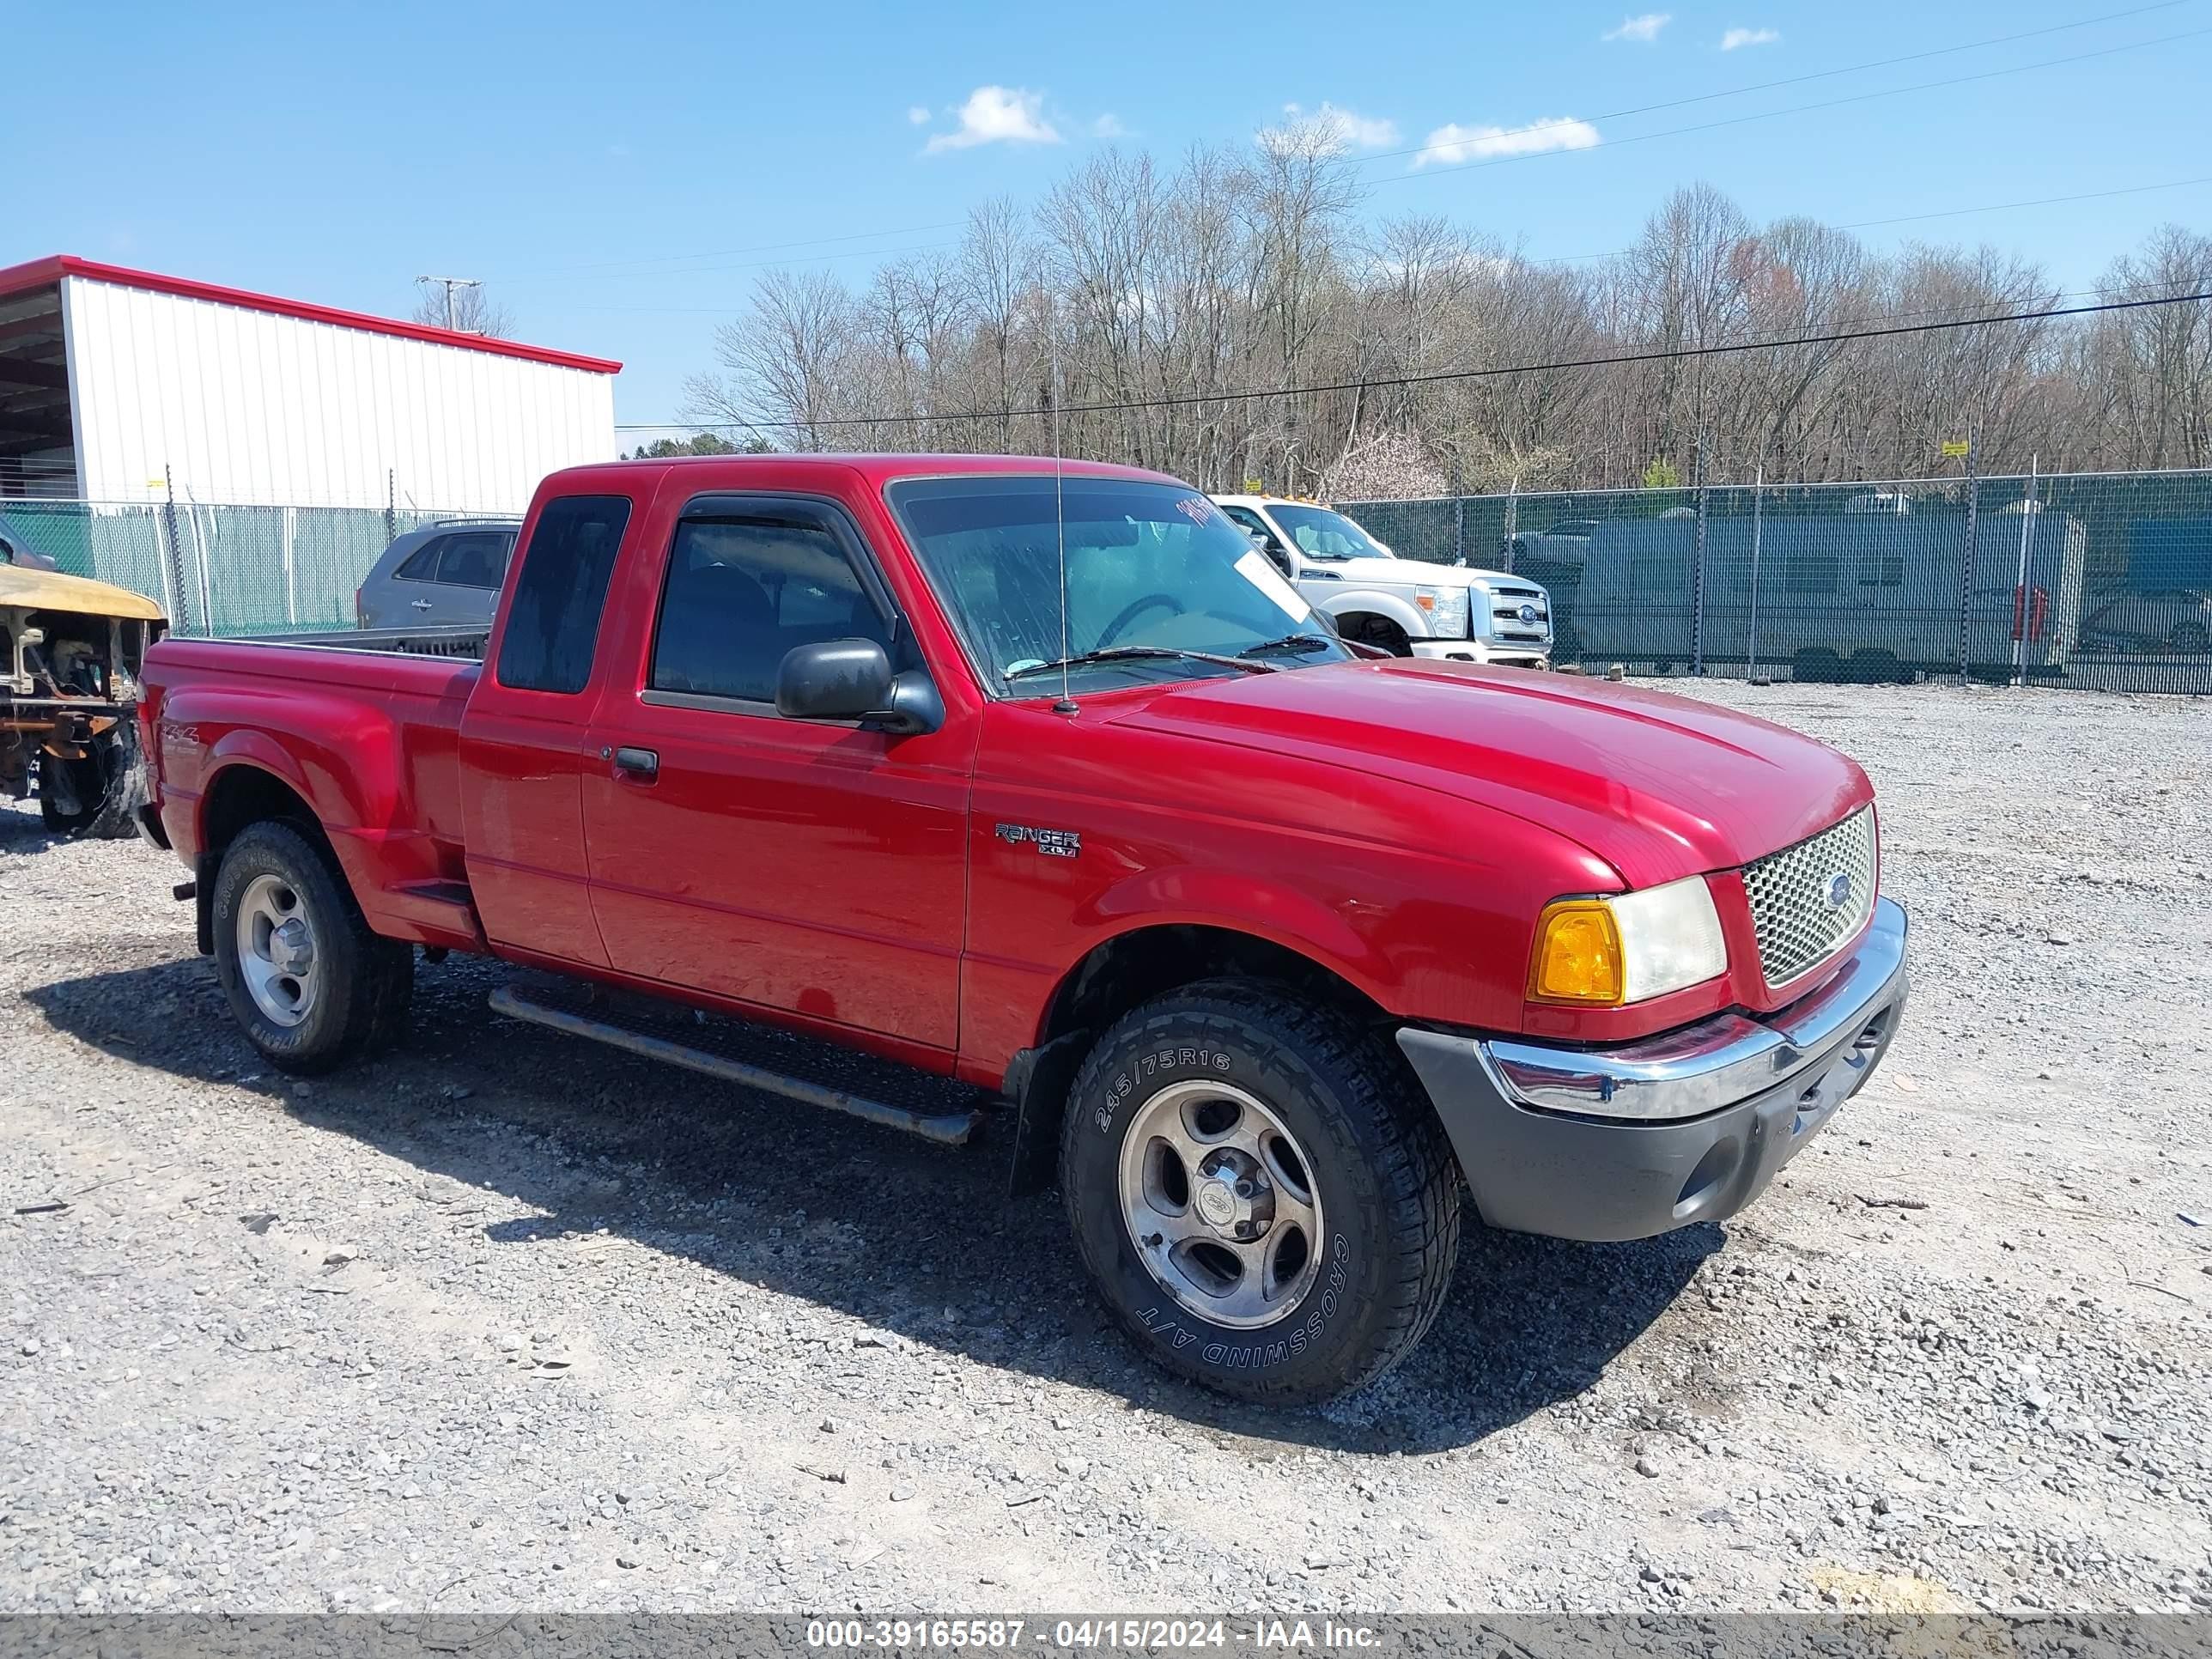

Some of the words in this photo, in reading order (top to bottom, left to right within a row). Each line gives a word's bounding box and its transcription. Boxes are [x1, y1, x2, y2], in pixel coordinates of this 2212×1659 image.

[995, 823, 1081, 849] RANGER
[1040, 844, 1073, 857] XLT
[1095, 1047, 1231, 1133] 245/75R16
[1201, 1232, 1351, 1368] CROSSWIND
[1135, 1307, 1198, 1349] A/T
